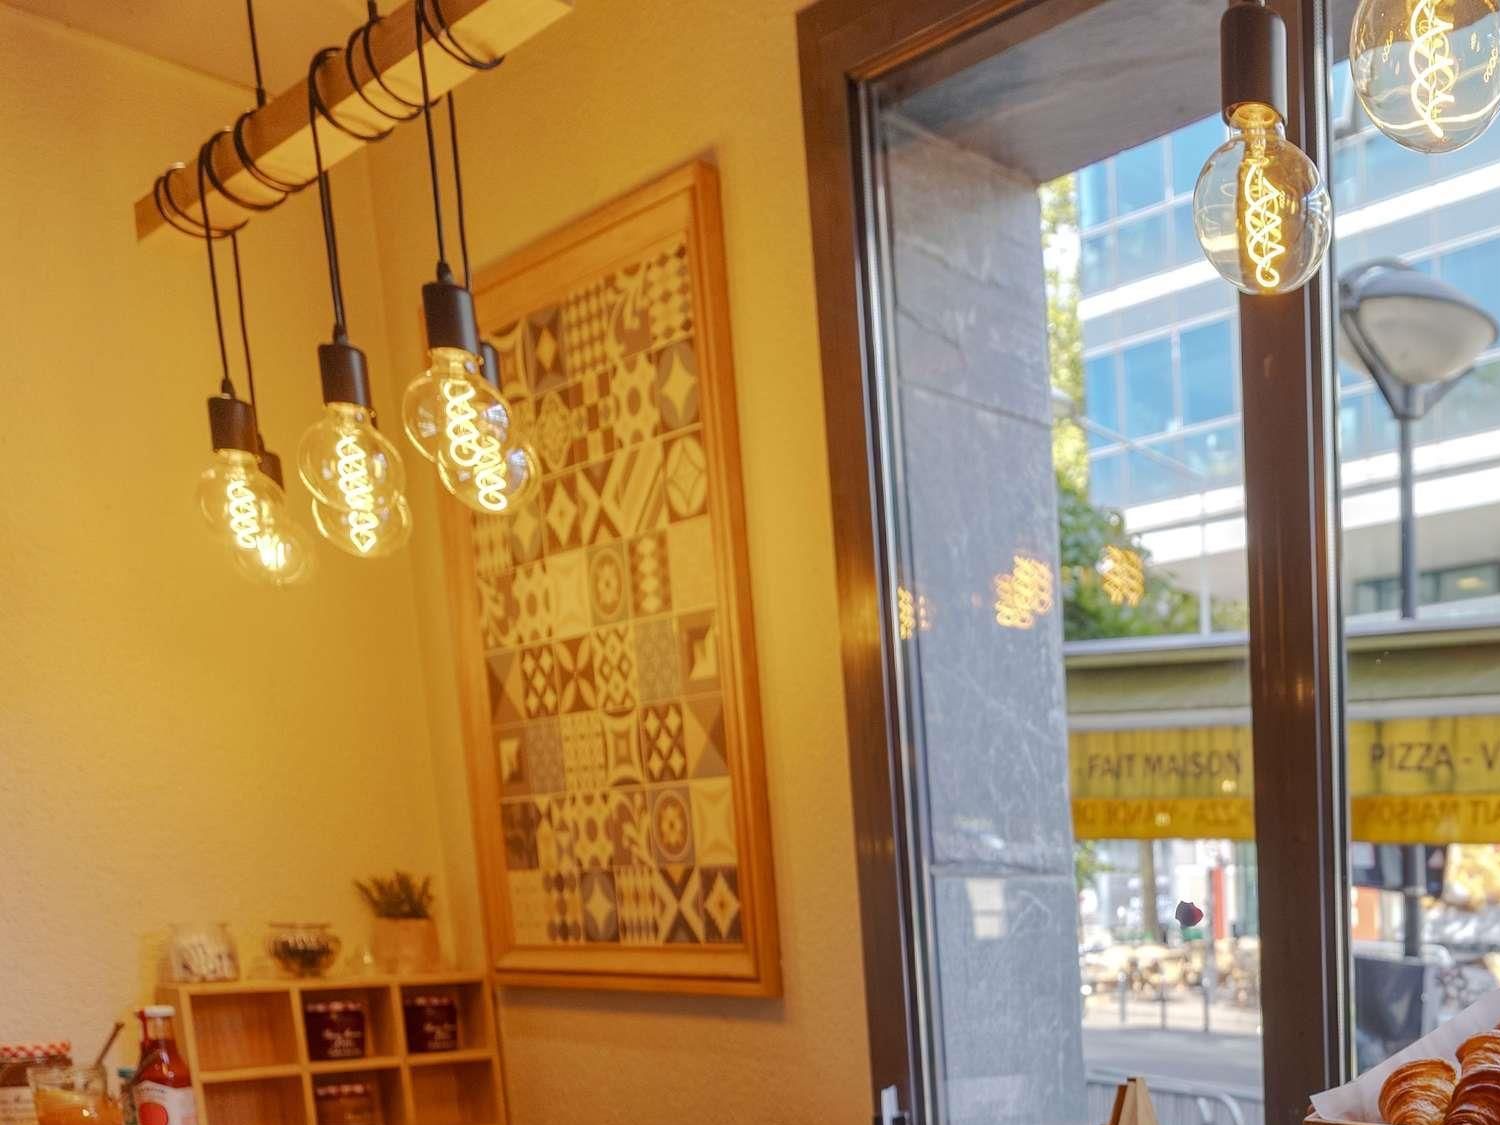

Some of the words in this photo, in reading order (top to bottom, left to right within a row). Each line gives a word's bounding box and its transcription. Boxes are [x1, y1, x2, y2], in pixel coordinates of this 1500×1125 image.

[1088, 753, 1136, 779] FAIT
[1143, 751, 1242, 778] MAISON
[1370, 742, 1452, 771] PIZZA
